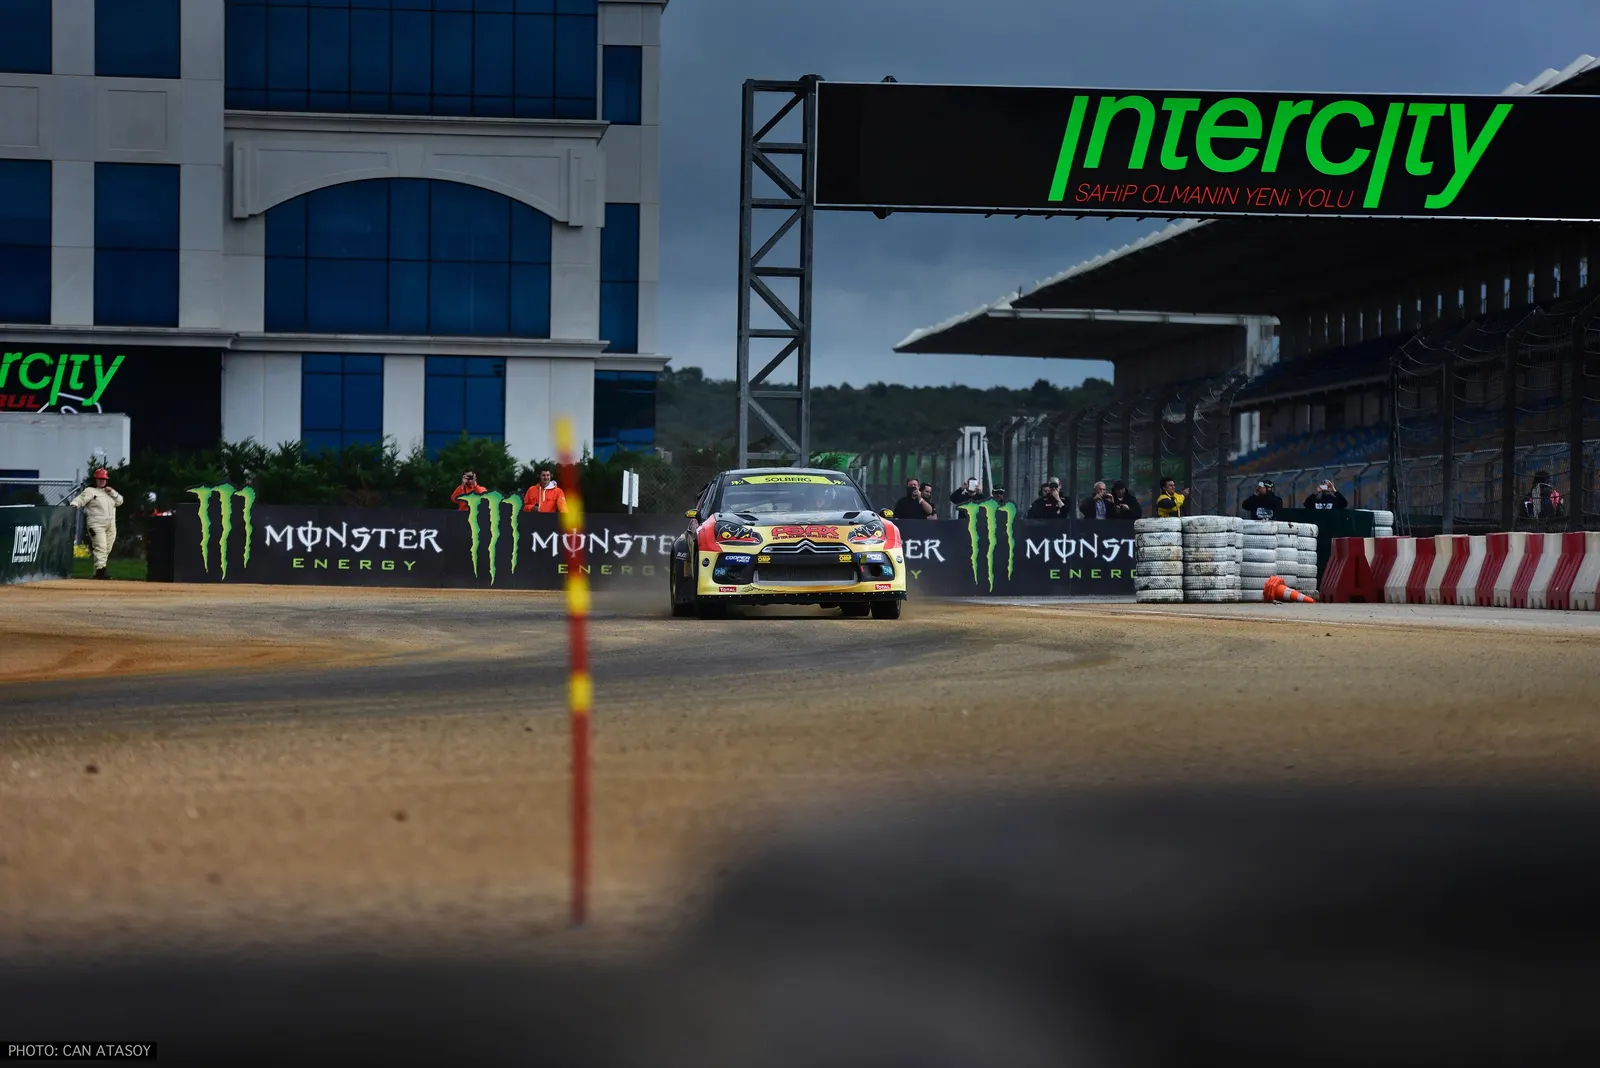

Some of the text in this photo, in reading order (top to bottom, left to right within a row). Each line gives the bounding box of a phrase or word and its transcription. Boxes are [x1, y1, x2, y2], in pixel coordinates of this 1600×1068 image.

[1141, 185, 1241, 206] OLMANIN
[1297, 188, 1355, 208] YOLU
[265, 521, 442, 561] MONSTER
[531, 527, 674, 559] MONSTE
[1026, 533, 1136, 564] MONST
[293, 557, 417, 571] ENERGY
[557, 563, 668, 576] ENERG
